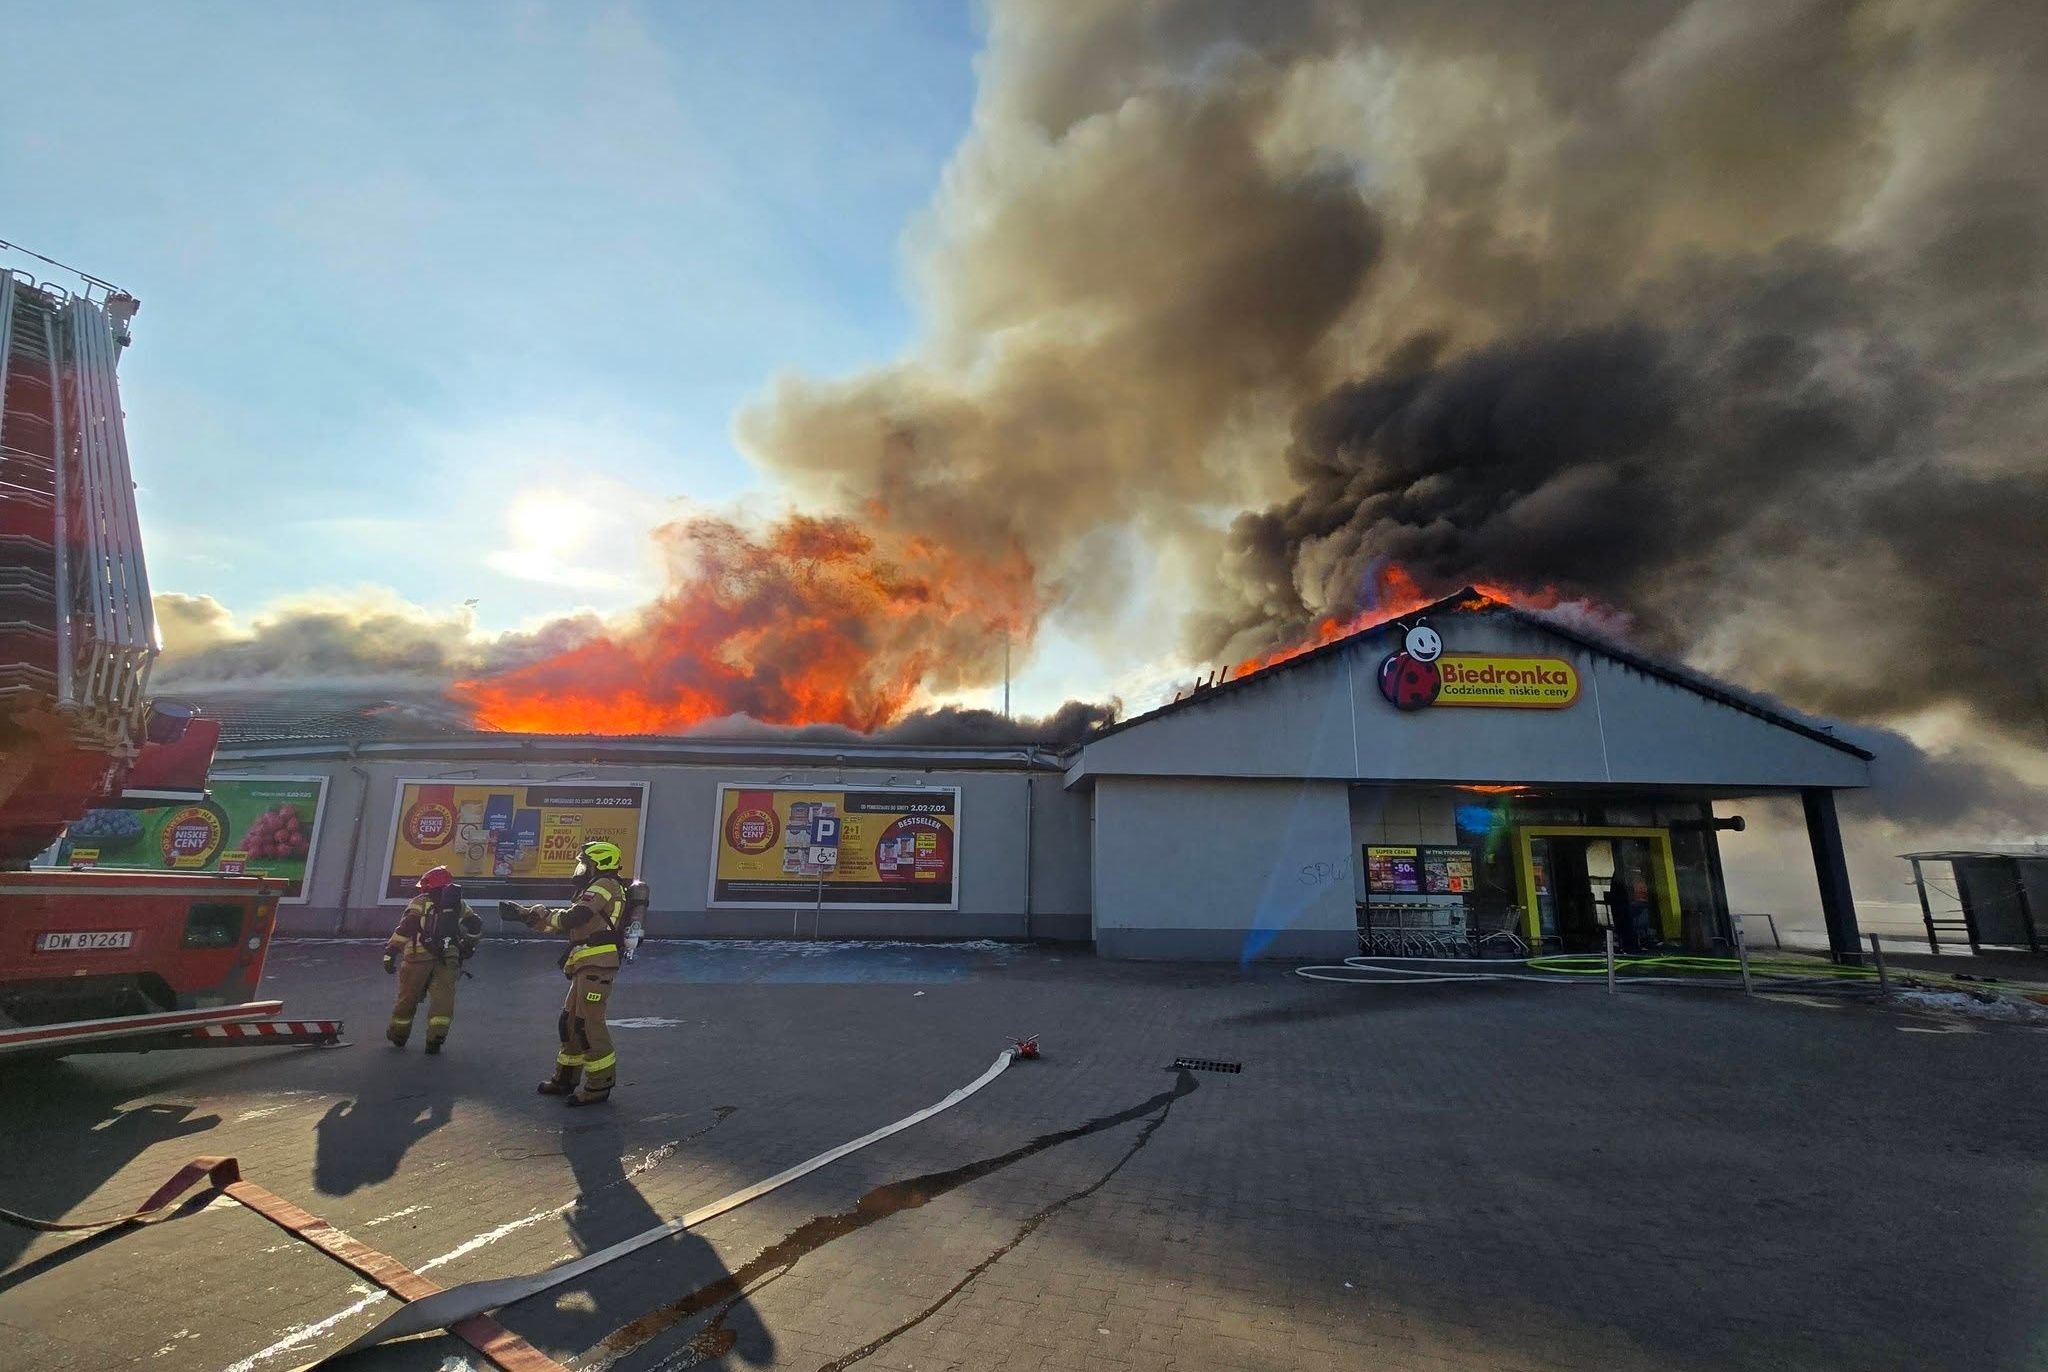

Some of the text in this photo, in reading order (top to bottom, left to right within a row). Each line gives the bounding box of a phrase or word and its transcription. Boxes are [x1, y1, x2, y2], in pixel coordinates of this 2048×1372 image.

[1441, 663, 1568, 685] Biedronka
[1444, 684, 1569, 698] Codziennie niskie ceny
[910, 804, 946, 812] 2.02-7.02
[897, 817, 942, 830] BESTSELLER
[175, 831, 208, 839] NISKIE
[816, 819, 835, 842] P
[174, 839, 206, 848] CENY
[543, 835, 578, 849] 50%
[49, 935, 73, 948] DW
